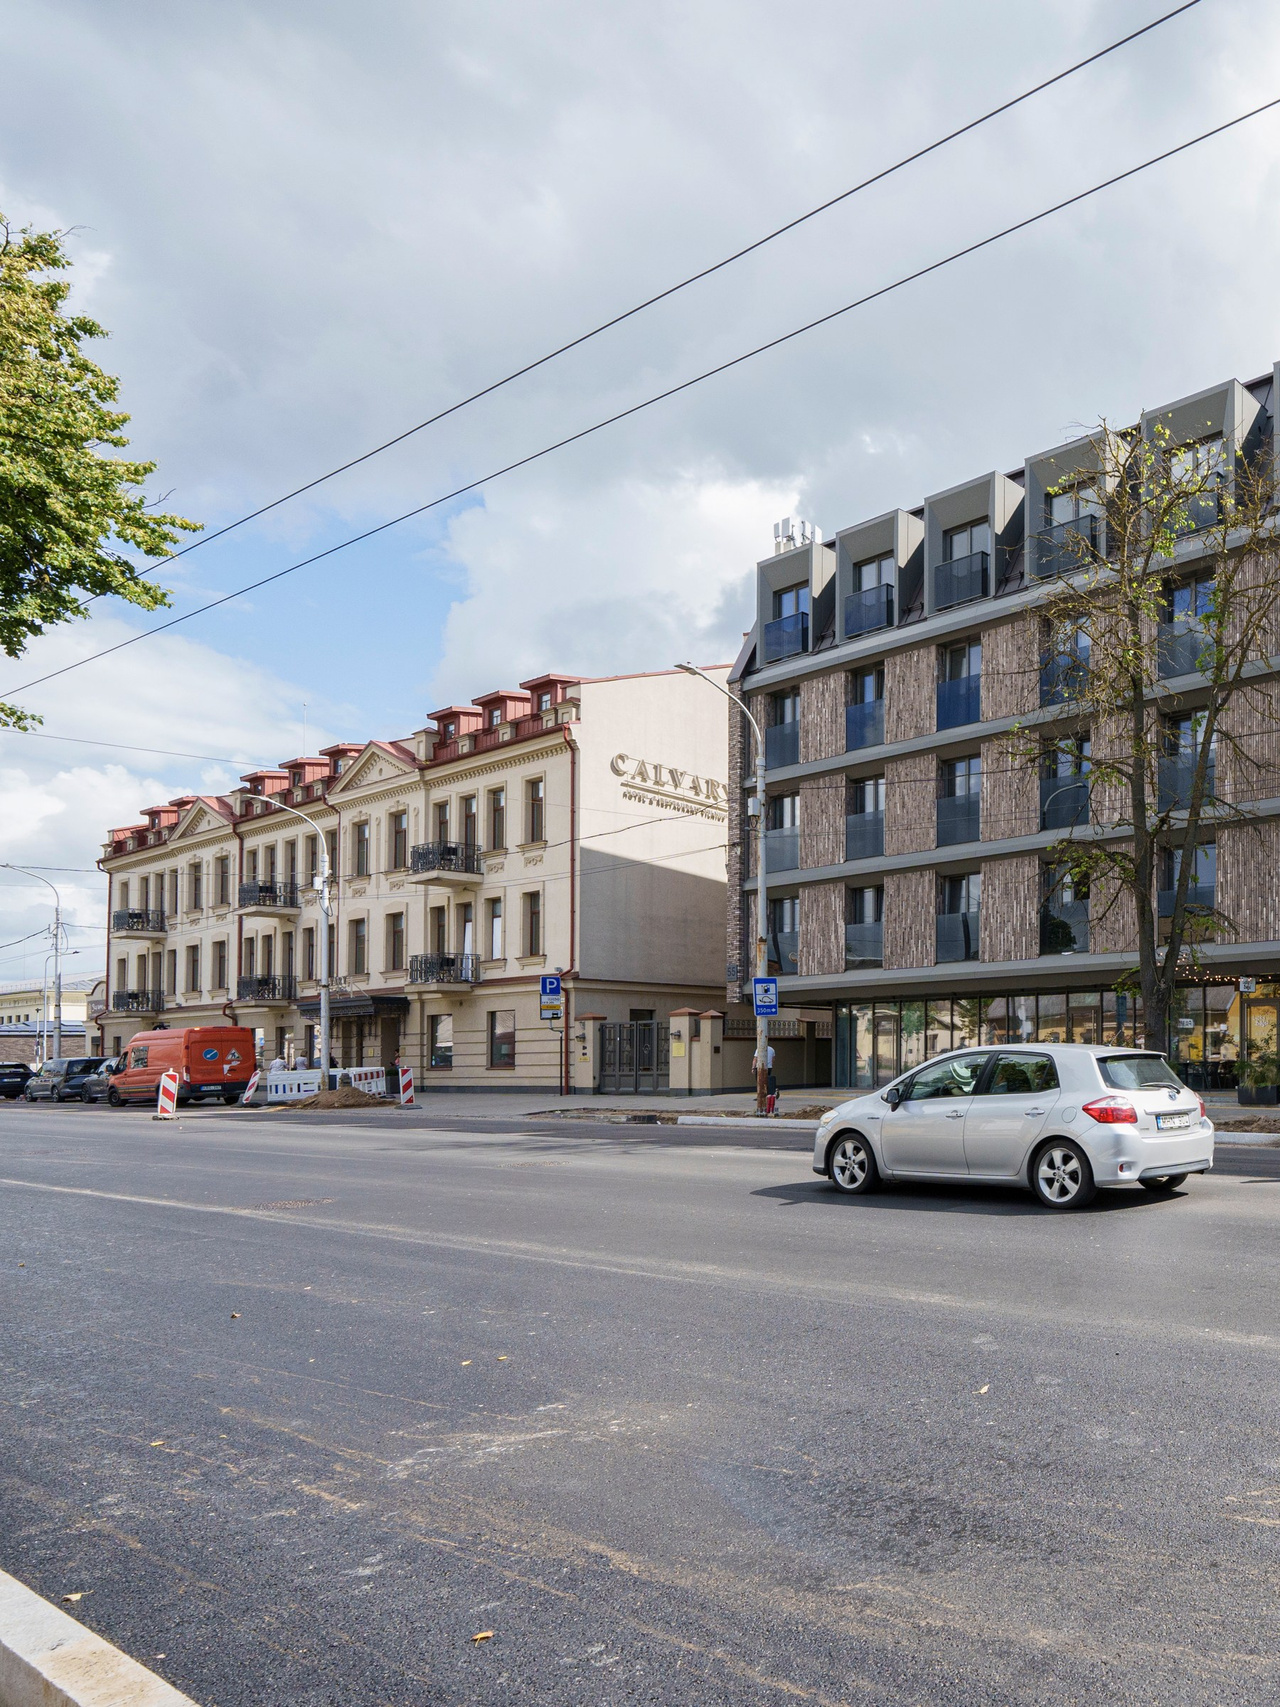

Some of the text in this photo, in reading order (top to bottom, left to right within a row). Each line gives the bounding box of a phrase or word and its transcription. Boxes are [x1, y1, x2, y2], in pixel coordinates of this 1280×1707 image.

[622, 789, 648, 804] HOTEL
[727, 967, 736, 977] 55
[546, 978, 557, 993] P
